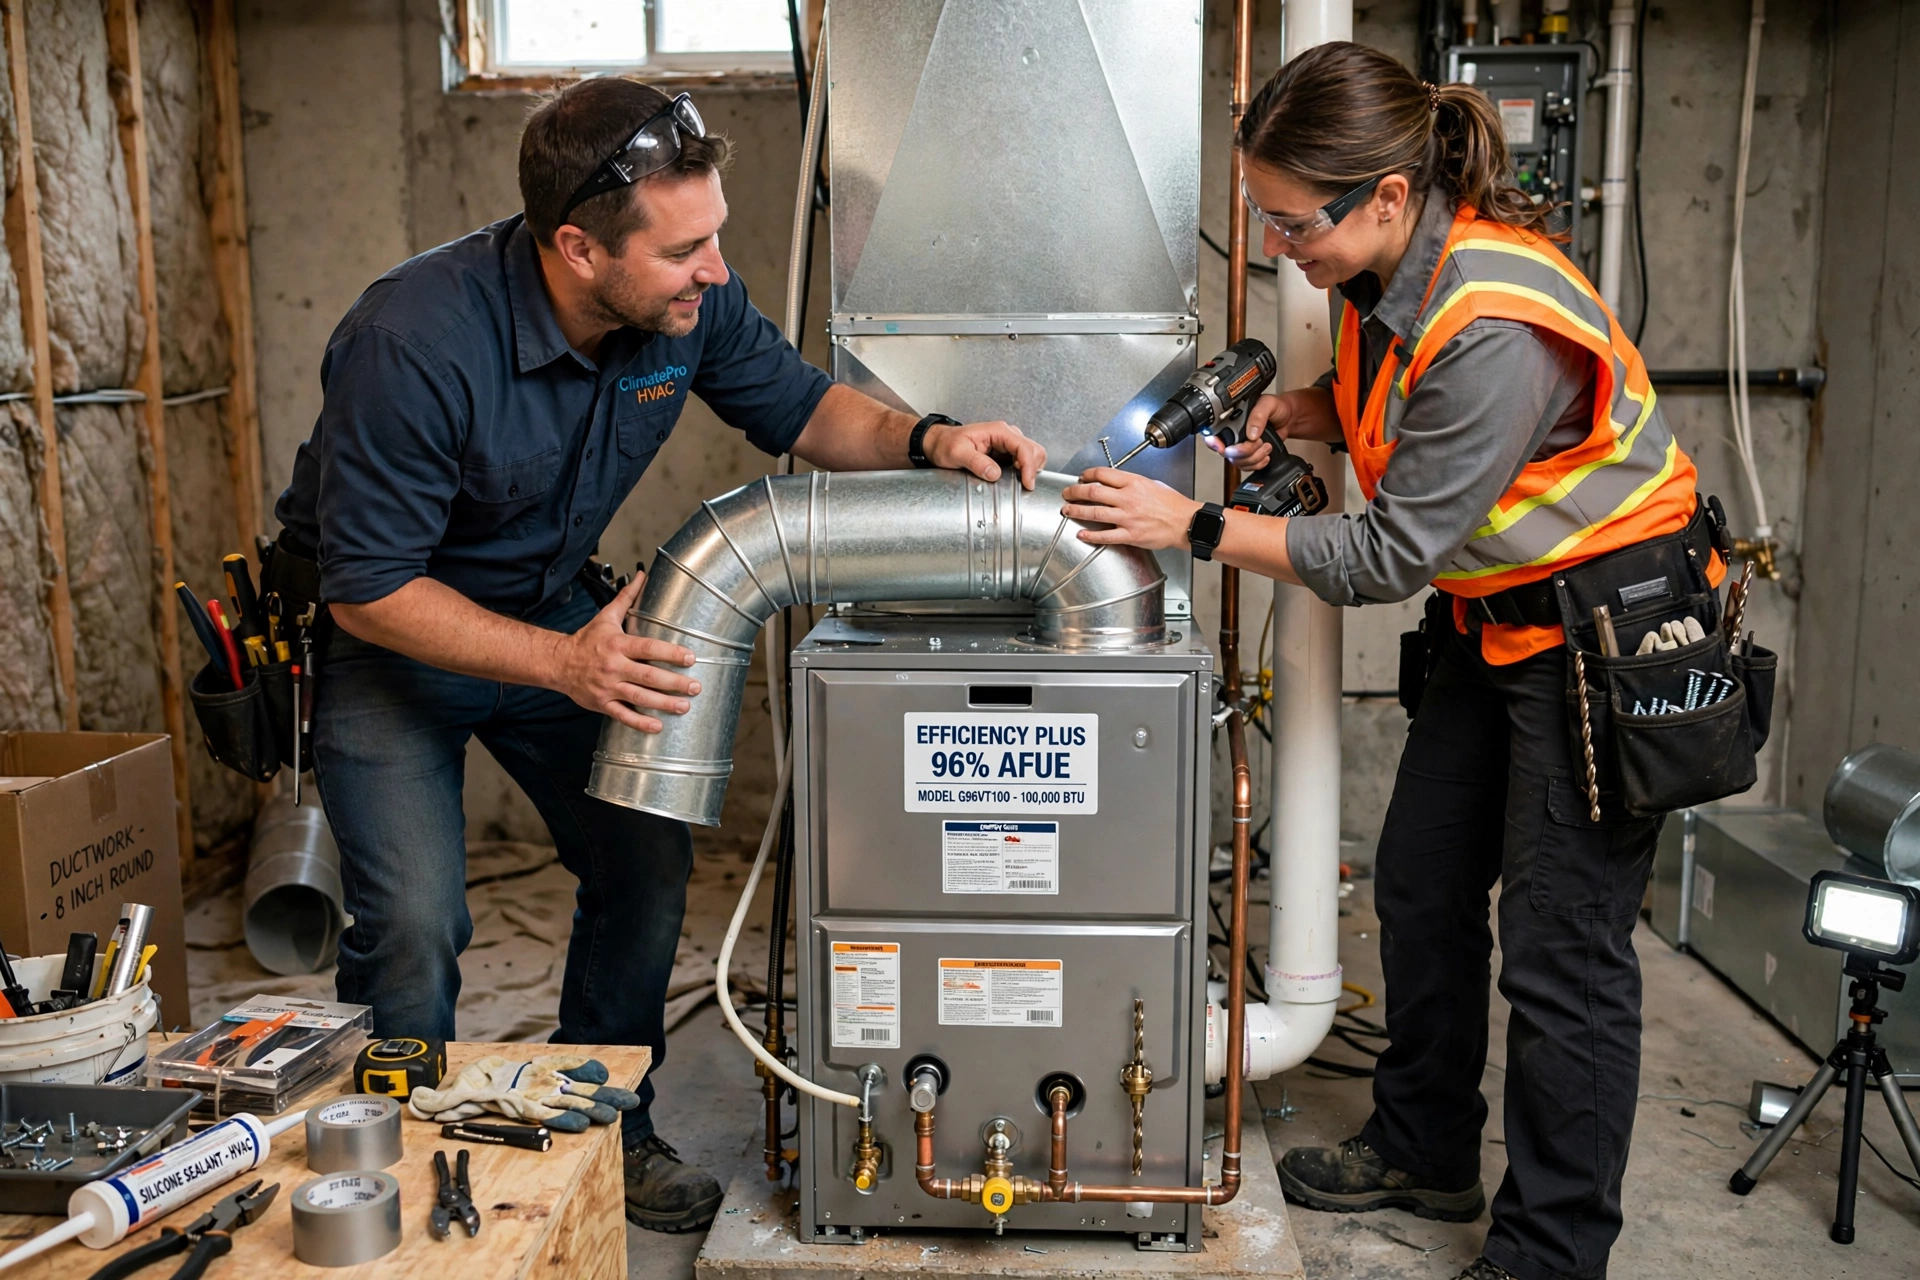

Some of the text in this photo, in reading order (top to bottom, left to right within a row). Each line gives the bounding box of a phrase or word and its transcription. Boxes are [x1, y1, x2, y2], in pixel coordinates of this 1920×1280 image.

[619, 365, 687, 392] ClimatePro
[637, 381, 676, 404] HVAC
[916, 724, 1086, 746] EFFICIENCY PLUS
[931, 751, 1070, 779] 96% AFUE
[918, 789, 955, 802] MODEL
[958, 790, 1010, 803] G96VT100
[1021, 791, 1060, 805] 100,000
[1063, 791, 1085, 804] BTU
[50, 824, 135, 888] DUCTWORK
[55, 895, 65, 920] 8
[70, 873, 104, 911] INCH
[109, 849, 154, 890] ROUND
[139, 1171, 185, 1205] SILICONE
[184, 1152, 224, 1184] SEALANT
[229, 1137, 253, 1160] HVAC
